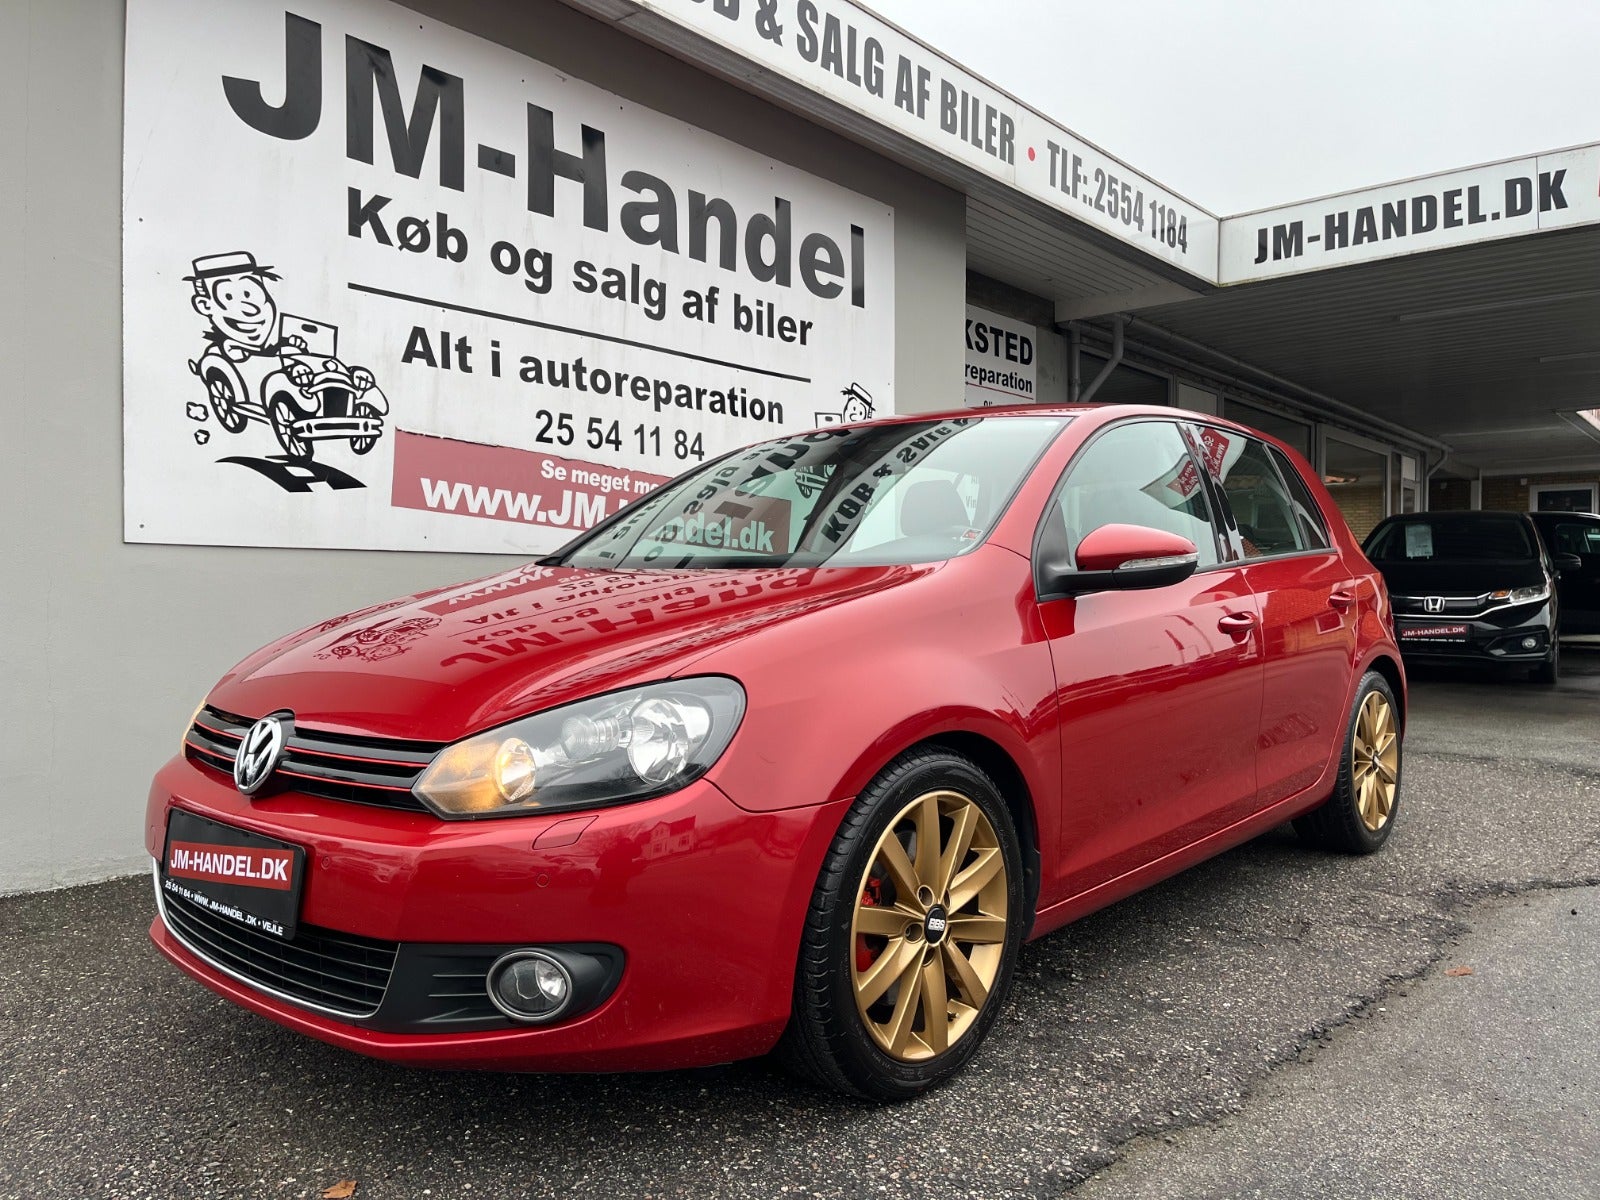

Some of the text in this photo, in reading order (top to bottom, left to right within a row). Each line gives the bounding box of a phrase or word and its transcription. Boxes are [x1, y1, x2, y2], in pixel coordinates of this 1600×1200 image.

[797, 0, 884, 99] SALG
[894, 57, 931, 121] AF
[940, 78, 1015, 165] BILER
[1149, 200, 1187, 254] 1184
[222, 11, 866, 309] JM-Handel
[1254, 168, 1569, 264] JM-HANDEL.DK
[348, 186, 814, 346] Køb og salg af biler
[401, 325, 784, 424] Alt i autoreparation
[965, 363, 1033, 393] reparation
[535, 409, 575, 447] 25
[586, 416, 623, 452] 54
[634, 423, 662, 457] 11
[674, 429, 705, 461] 84
[540, 459, 567, 480] Se
[571, 468, 631, 493] meget
[1403, 627, 1465, 636] JM-HANDEL.DK
[171, 849, 289, 881] JM-HANDEL.DK
[262, 920, 284, 937] VEJLE
[928, 917, 946, 931] BBS
